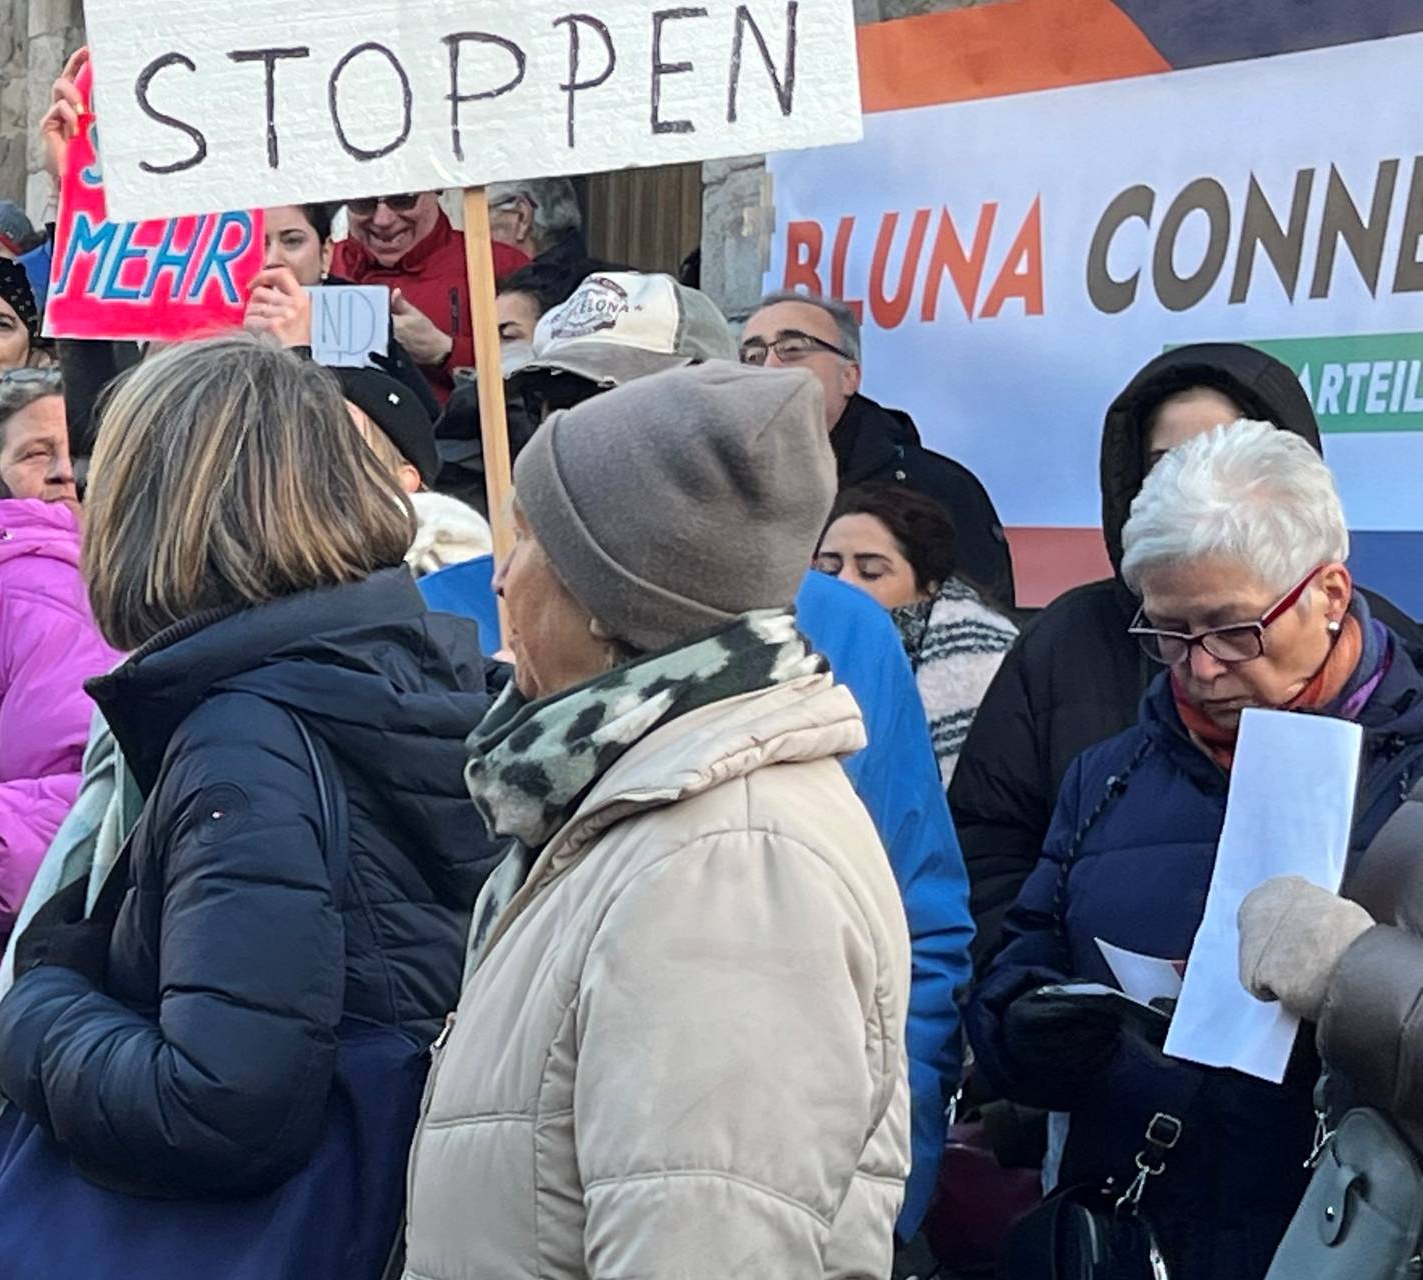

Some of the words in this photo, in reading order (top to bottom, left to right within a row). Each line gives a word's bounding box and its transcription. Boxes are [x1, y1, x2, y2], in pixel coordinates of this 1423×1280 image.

[134, 0, 798, 175] STOPPEN
[54, 209, 253, 303] MEHR
[783, 192, 1045, 330] BLUNA
[309, 288, 377, 357] ND
